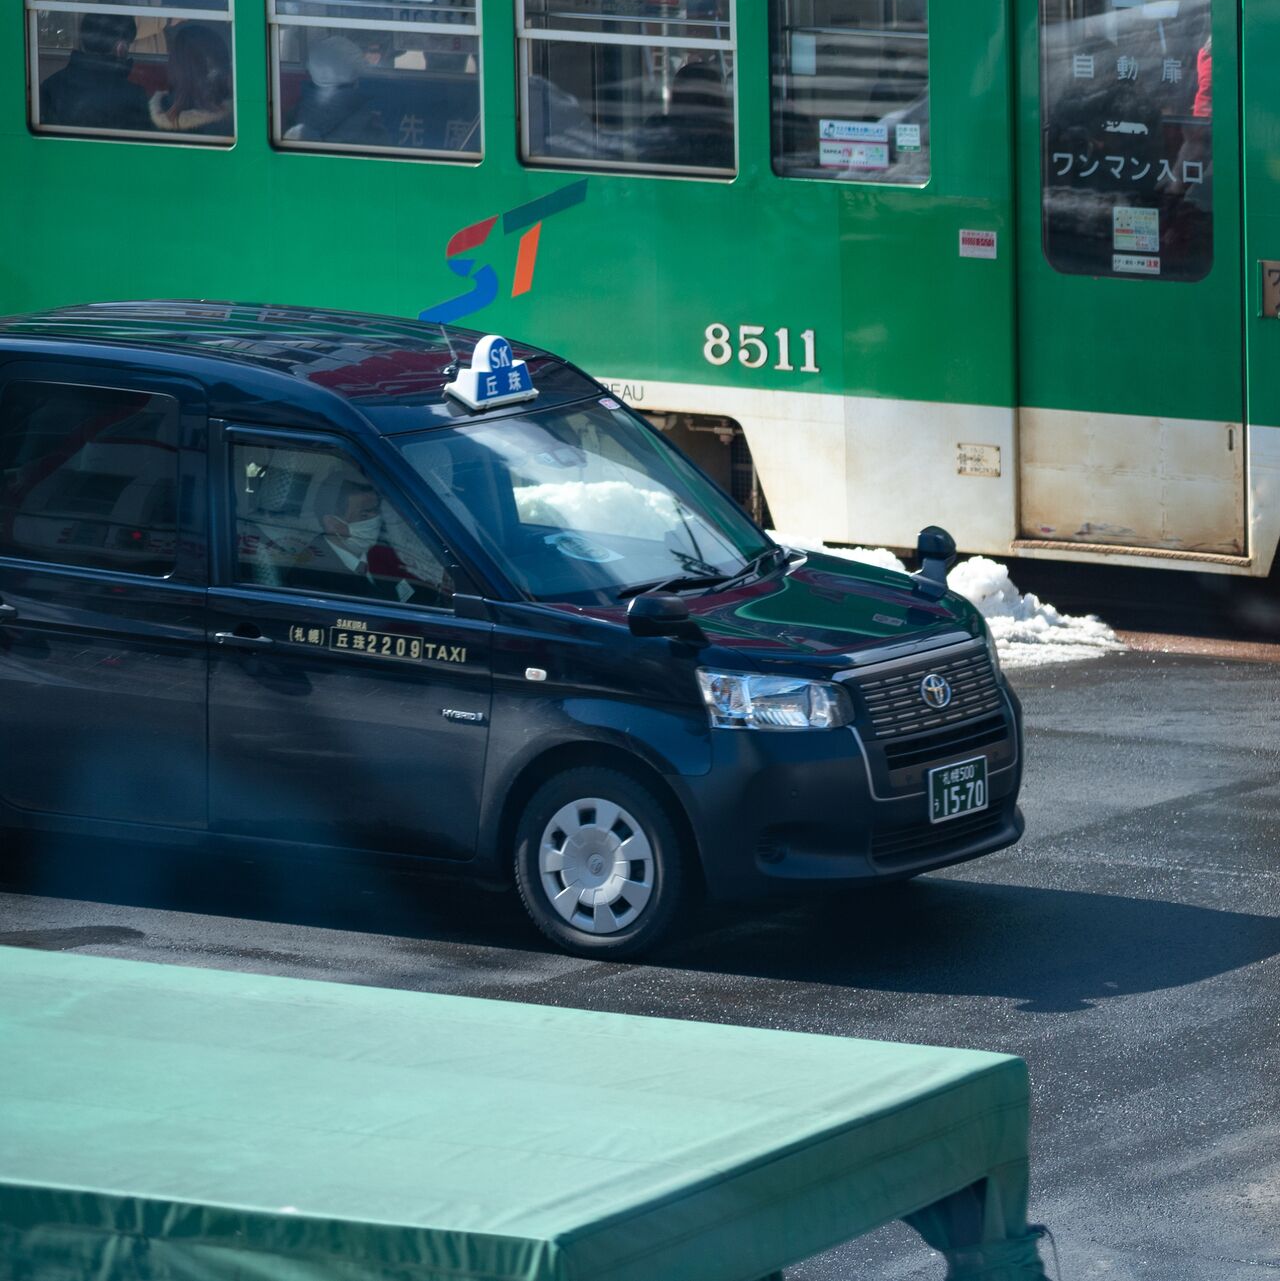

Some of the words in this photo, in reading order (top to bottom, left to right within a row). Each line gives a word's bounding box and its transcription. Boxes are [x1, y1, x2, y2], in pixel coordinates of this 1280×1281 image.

[1073, 54, 1183, 84] 自動扉
[1053, 152, 1204, 184] ワンマン入口
[490, 345, 511, 369] SK
[703, 322, 820, 373] 8511
[485, 370, 522, 397] 丘珠
[336, 618, 368, 631] SAKURA
[425, 643, 467, 663] TAXI
[944, 779, 984, 816] 15-70
